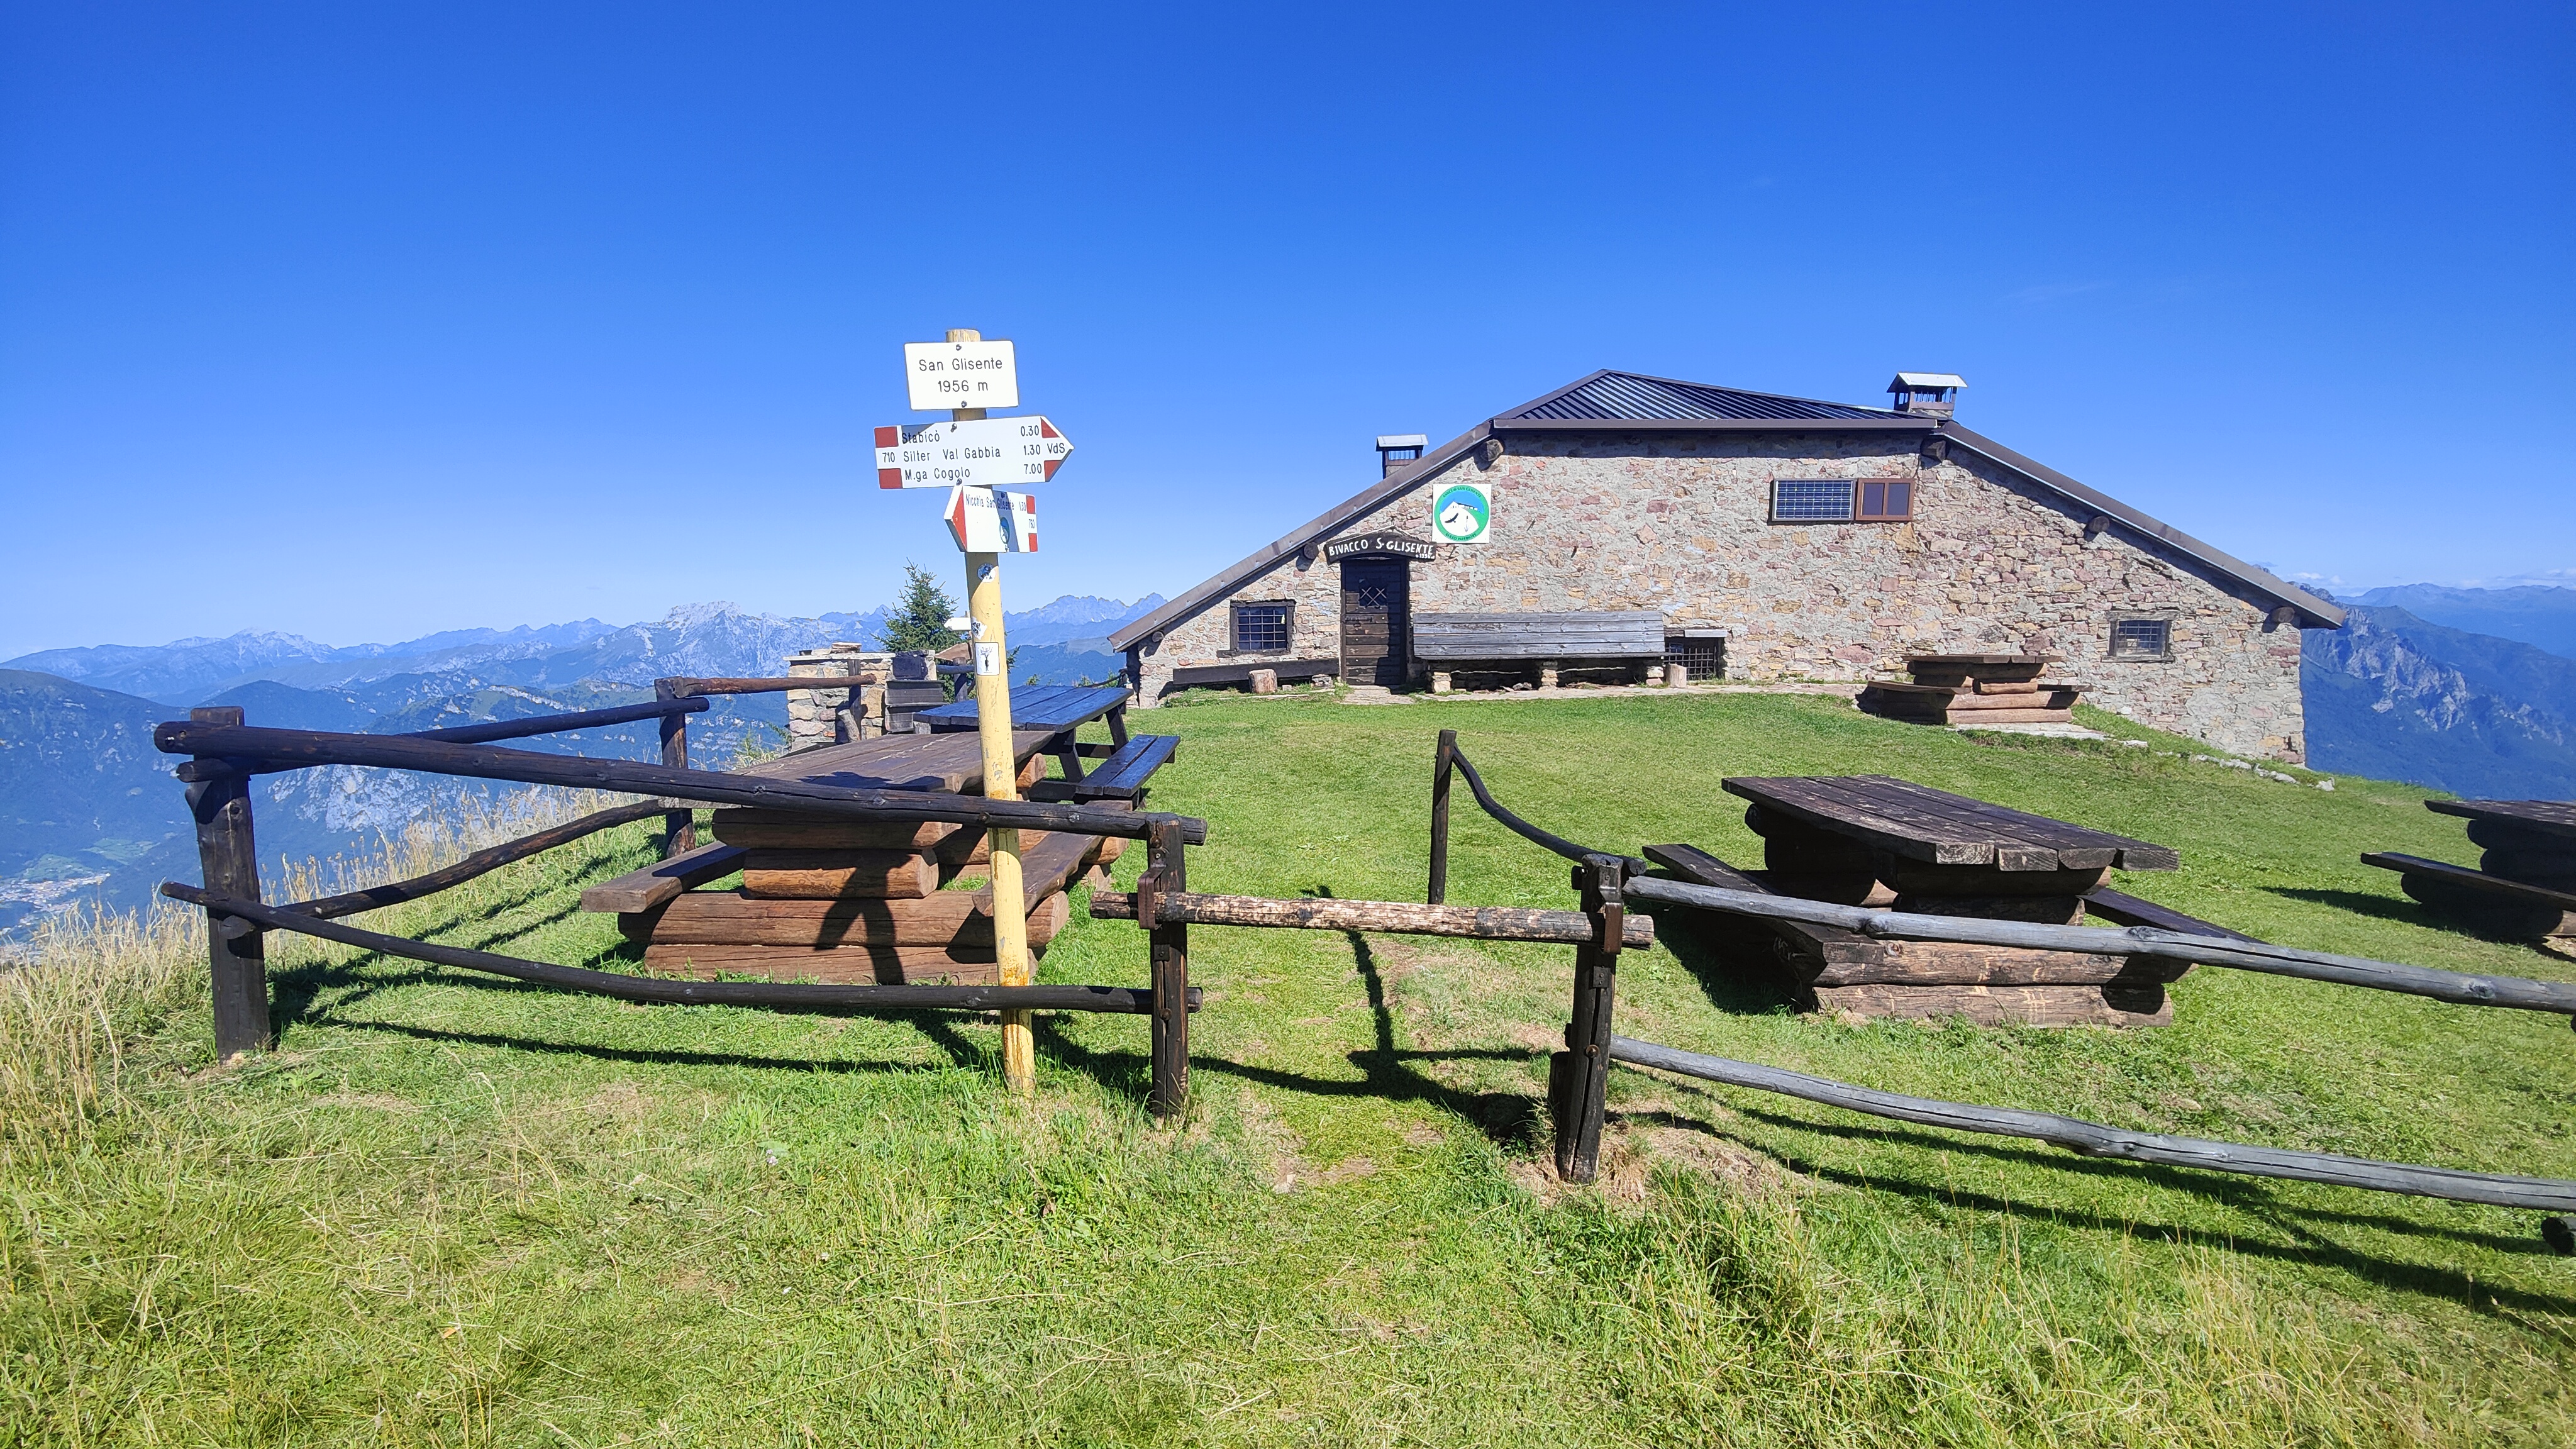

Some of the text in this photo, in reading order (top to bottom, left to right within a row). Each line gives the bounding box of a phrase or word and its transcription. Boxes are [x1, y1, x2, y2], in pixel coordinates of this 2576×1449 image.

[919, 357, 1002, 372] San Glisente
[938, 380, 989, 392] 1956 m
[902, 425, 1040, 444] Stabicò 0.30
[882, 442, 1065, 463] 710 Silter Val Gabbia 1.30 VdS
[904, 467, 970, 482] M.ga Cogolo
[1023, 463, 1042, 475] 7.00
[965, 494, 984, 508] Nicchia
[986, 496, 996, 509] San
[1328, 539, 1368, 556] BIVACCO
[1385, 540, 1434, 555] GLISENTE
